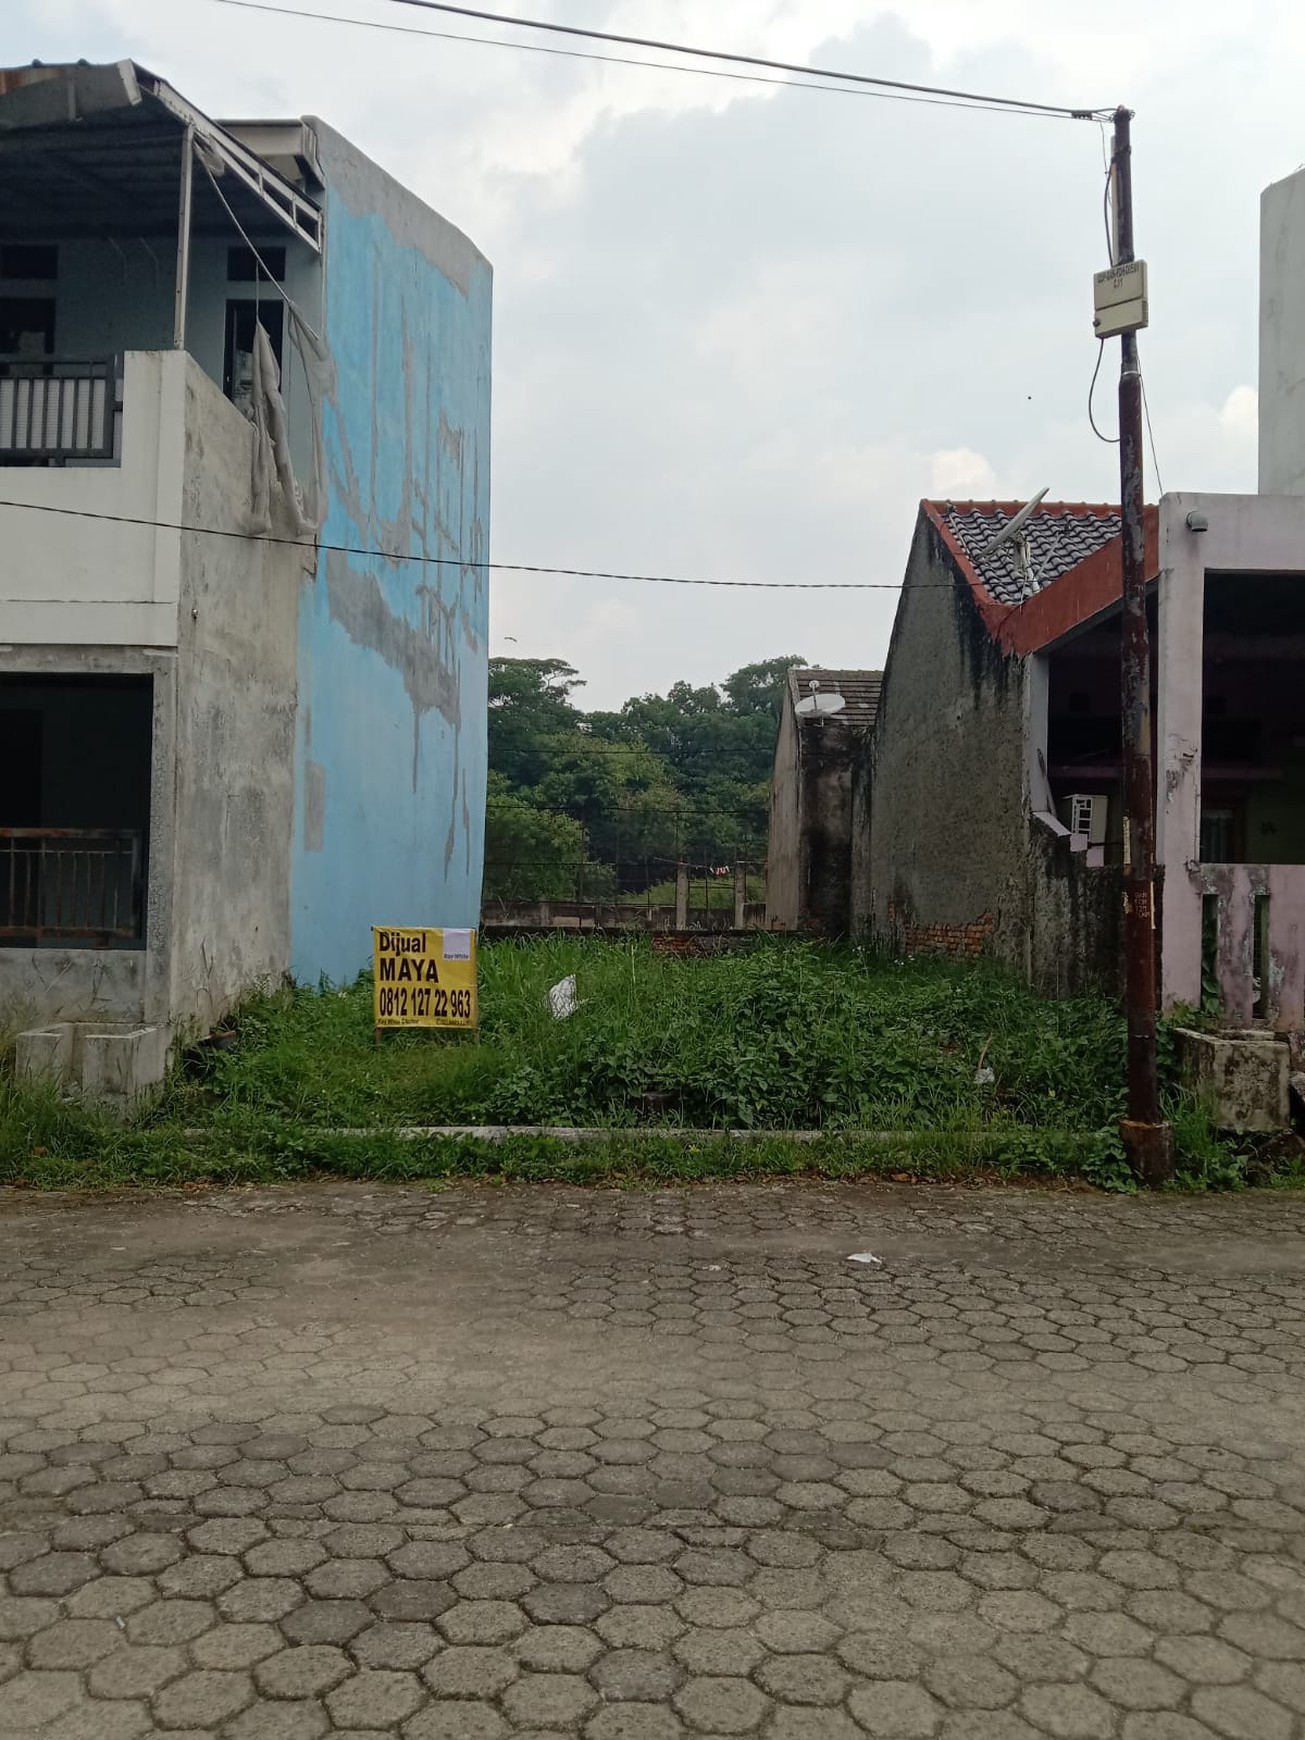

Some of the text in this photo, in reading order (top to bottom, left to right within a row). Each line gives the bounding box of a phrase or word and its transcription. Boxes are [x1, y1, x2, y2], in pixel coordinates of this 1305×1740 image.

[379, 932, 426, 956] Dijual
[380, 958, 439, 983] MAYA
[379, 987, 471, 1018] 0812 127 22 963
